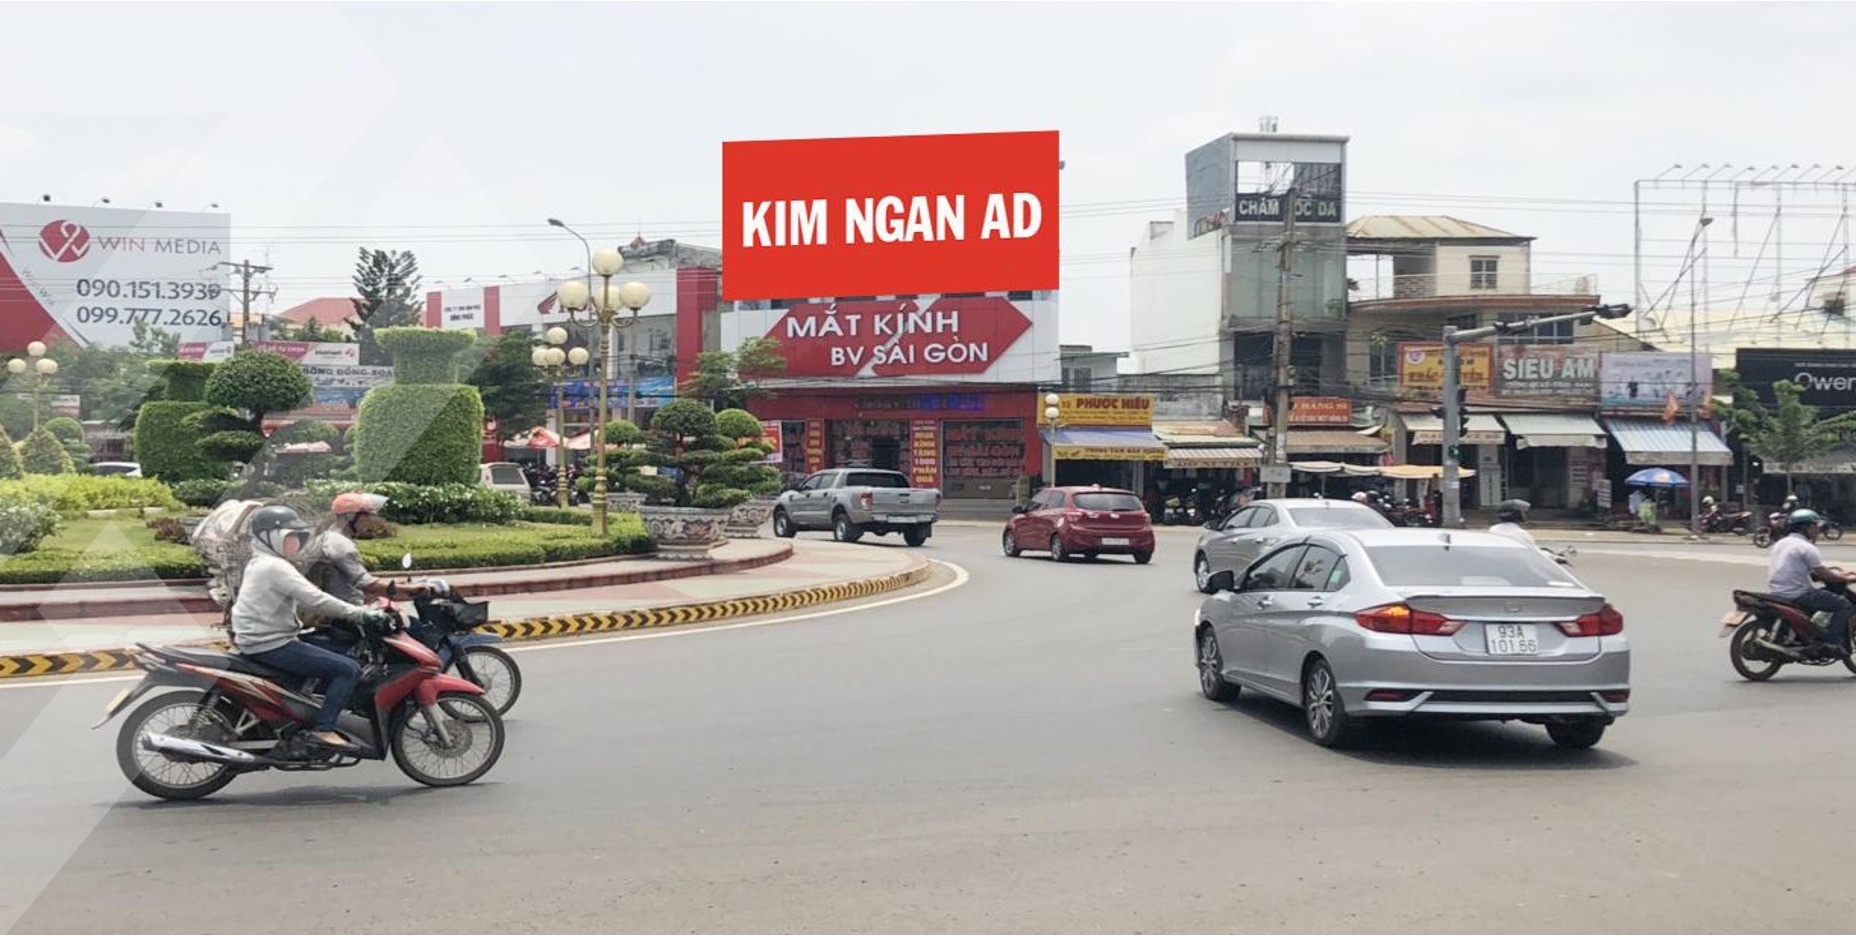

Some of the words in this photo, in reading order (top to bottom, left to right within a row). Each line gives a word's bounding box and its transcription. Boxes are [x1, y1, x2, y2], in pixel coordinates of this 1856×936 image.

[1317, 202, 1337, 216] DA
[97, 236, 146, 253] WIN
[154, 238, 222, 256] MEDIA
[76, 306, 222, 327] 099.777.2626
[787, 303, 861, 338] MẮT
[874, 302, 959, 336] KÍNH
[831, 346, 864, 366] BV
[924, 336, 988, 365] GÒN
[1497, 625, 1525, 638] 93A
